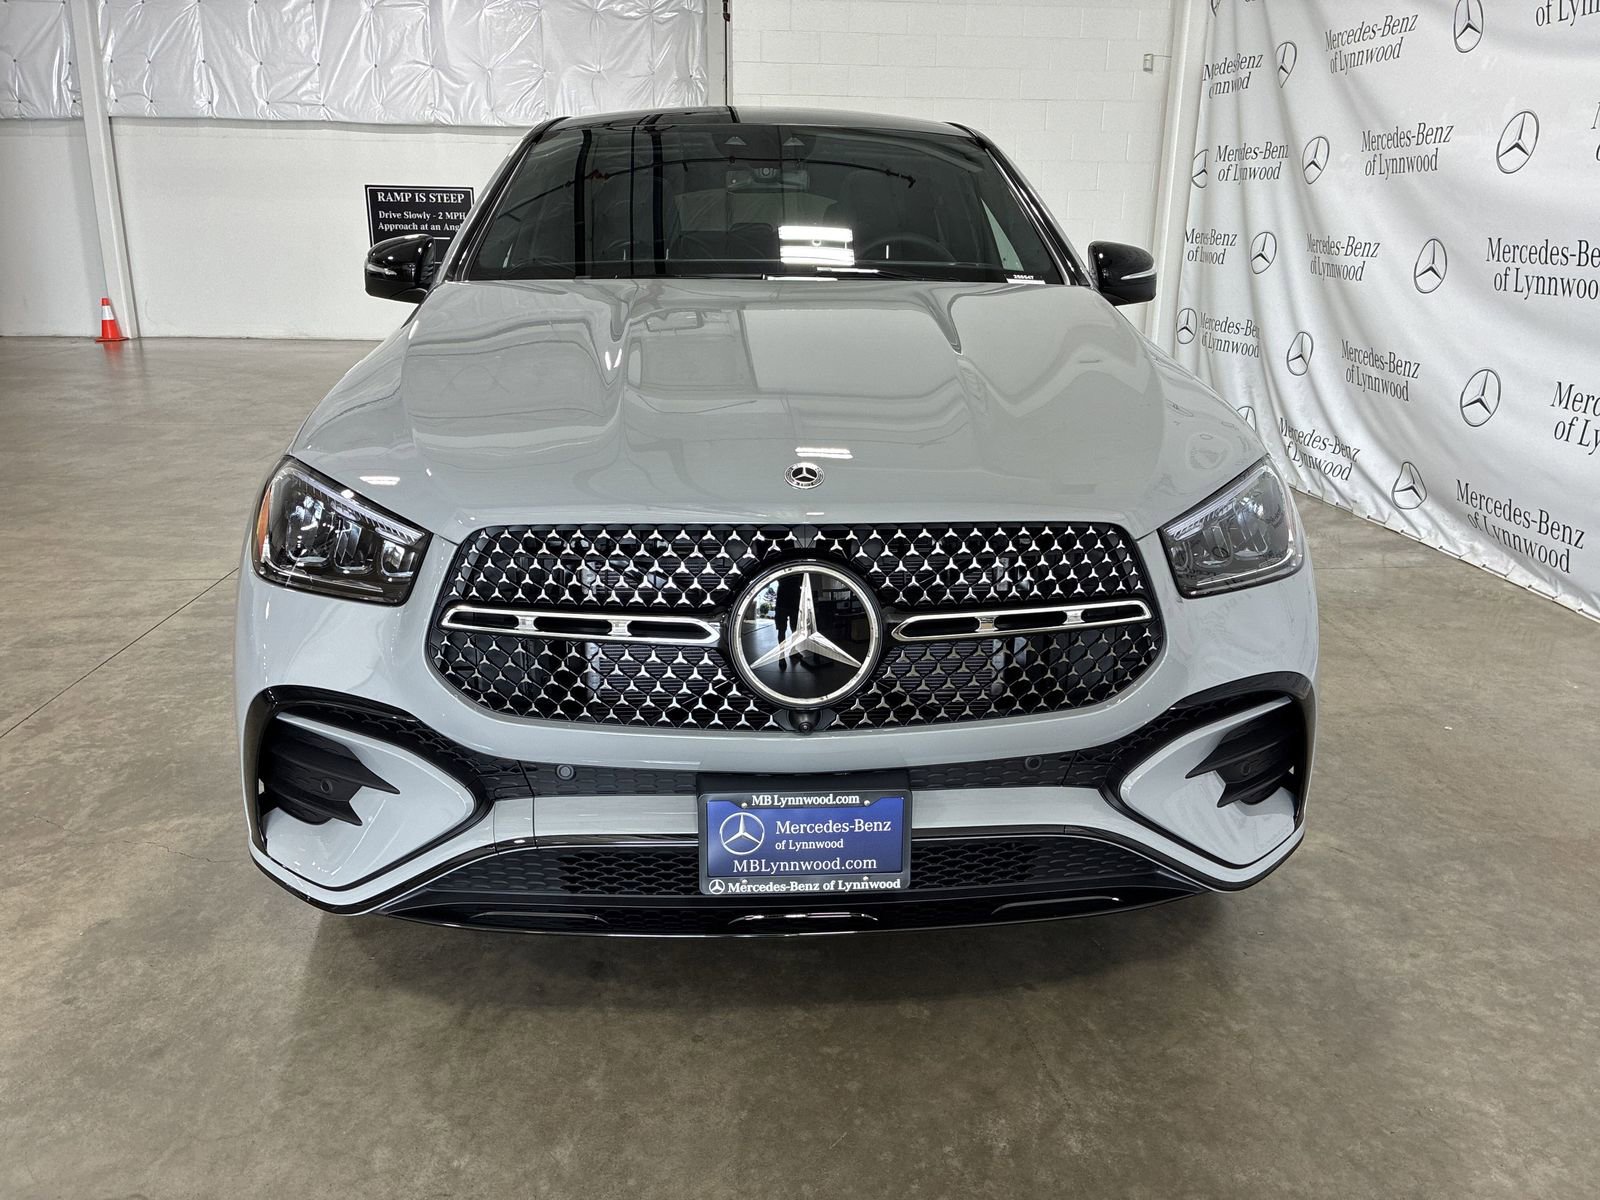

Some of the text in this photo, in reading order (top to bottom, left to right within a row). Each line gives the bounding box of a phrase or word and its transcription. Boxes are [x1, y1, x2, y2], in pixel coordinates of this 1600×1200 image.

[1325, 14, 1418, 51] Mercedes-Benz
[1330, 37, 1403, 75] of Lynnwood
[1361, 122, 1454, 152] Mercedes-Benz
[1218, 163, 1232, 182] of
[1365, 147, 1438, 180] of Lynnwood
[377, 192, 465, 203] RAMP IS STEEP
[378, 210, 402, 219] Drive
[403, 211, 431, 221] Slowly
[445, 212, 467, 220] MPH
[378, 222, 418, 232] Approach
[1187, 246, 1200, 262] of
[1306, 233, 1381, 258] Mercedes-Benz
[1485, 237, 1600, 268] Mercedes-Be
[1317, 256, 1366, 281] Lynnwood
[1494, 266, 1599, 300] of Lynnwoo
[1341, 339, 1421, 379] Mercedes-Benz
[1345, 364, 1410, 402] of Lynnwood
[1554, 416, 1579, 442] of
[1456, 479, 1585, 550] Mercedes-Benz
[1483, 514, 1571, 574] Lynnwood
[775, 818, 891, 835] Mercedes-Benz
[775, 838, 844, 851] of Lynnwood
[733, 857, 877, 874] MBLynnwood.com
[727, 878, 901, 894] Mercedes-Benz of Lynnwood
